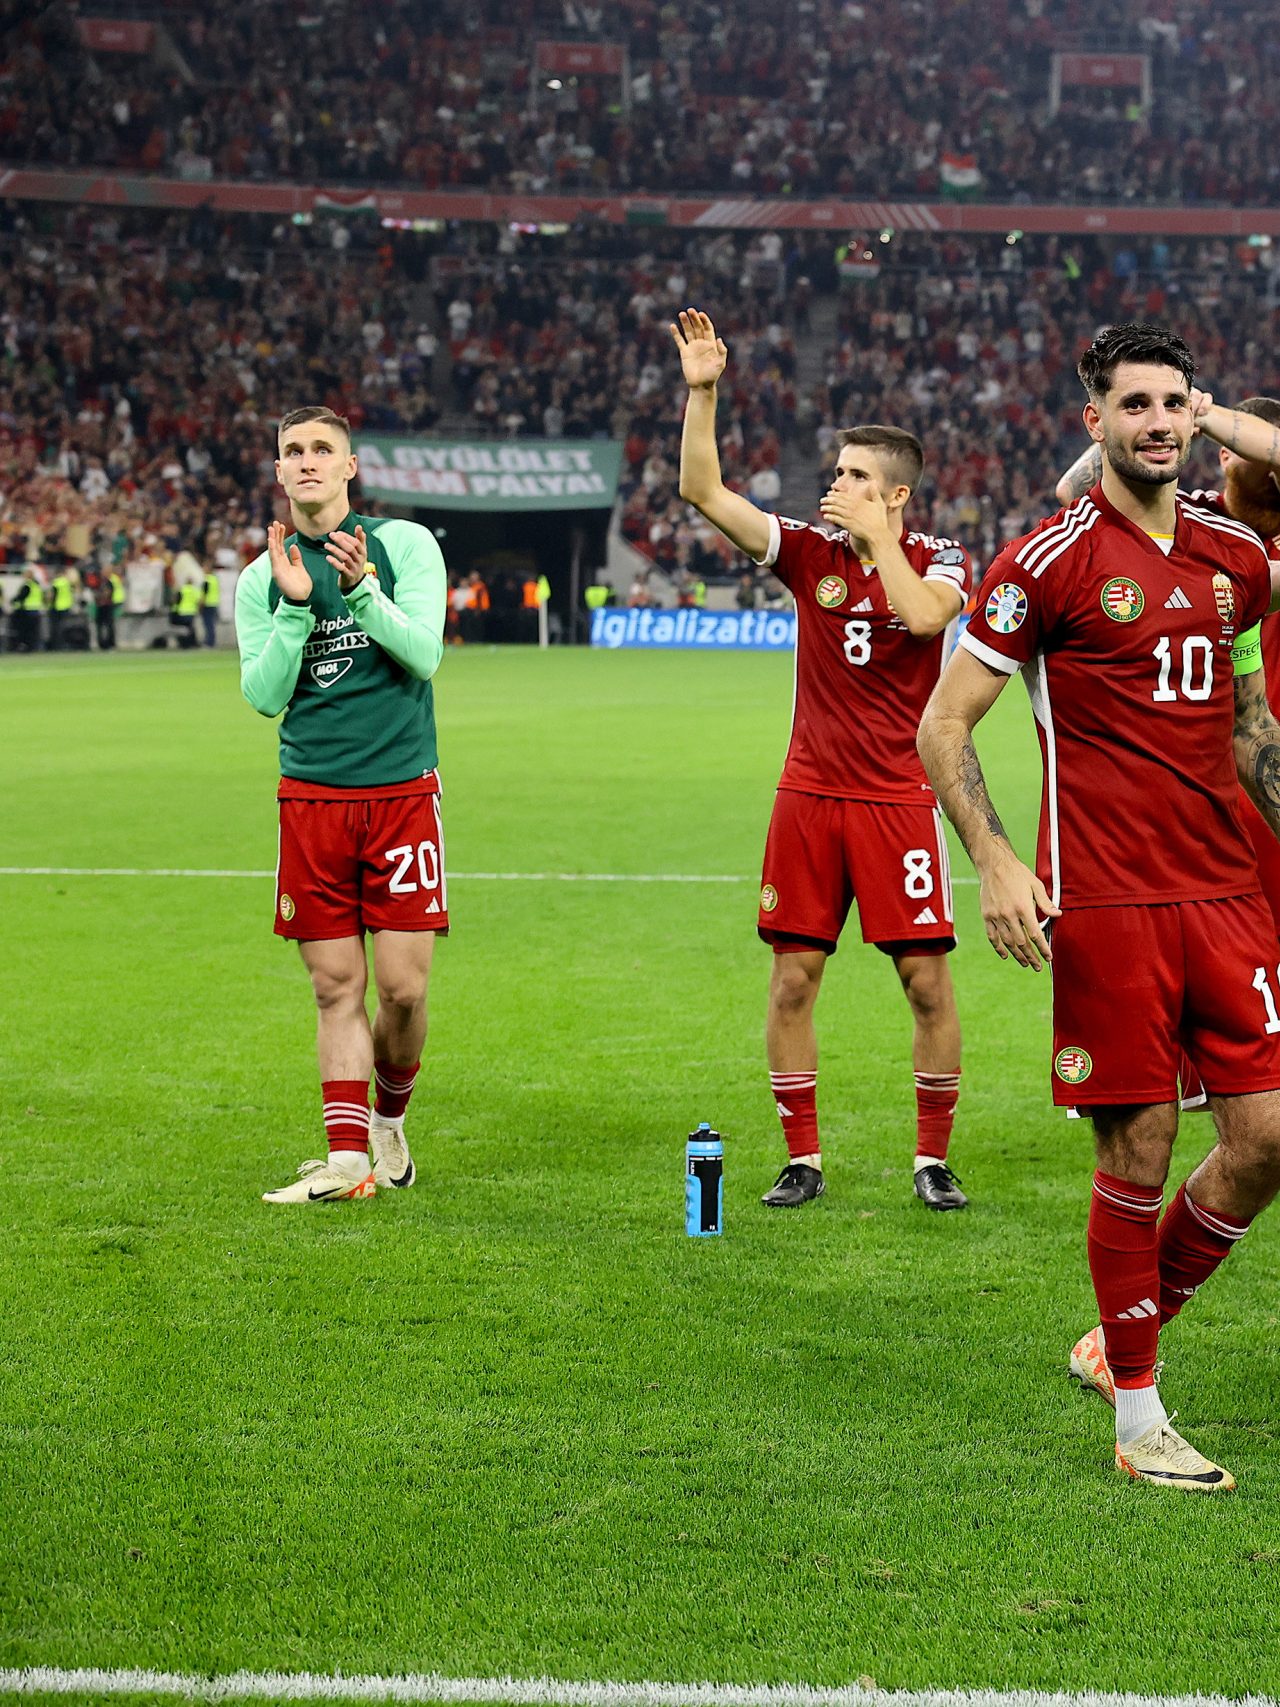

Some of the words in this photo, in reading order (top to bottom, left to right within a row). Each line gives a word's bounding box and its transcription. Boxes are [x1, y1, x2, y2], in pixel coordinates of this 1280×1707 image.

[358, 445, 386, 466] A
[360, 467, 468, 495] NEM
[843, 620, 872, 666] 8
[316, 663, 338, 677] MOL
[1152, 635, 1214, 701] 10
[385, 840, 439, 893] 20
[903, 849, 933, 899] 8
